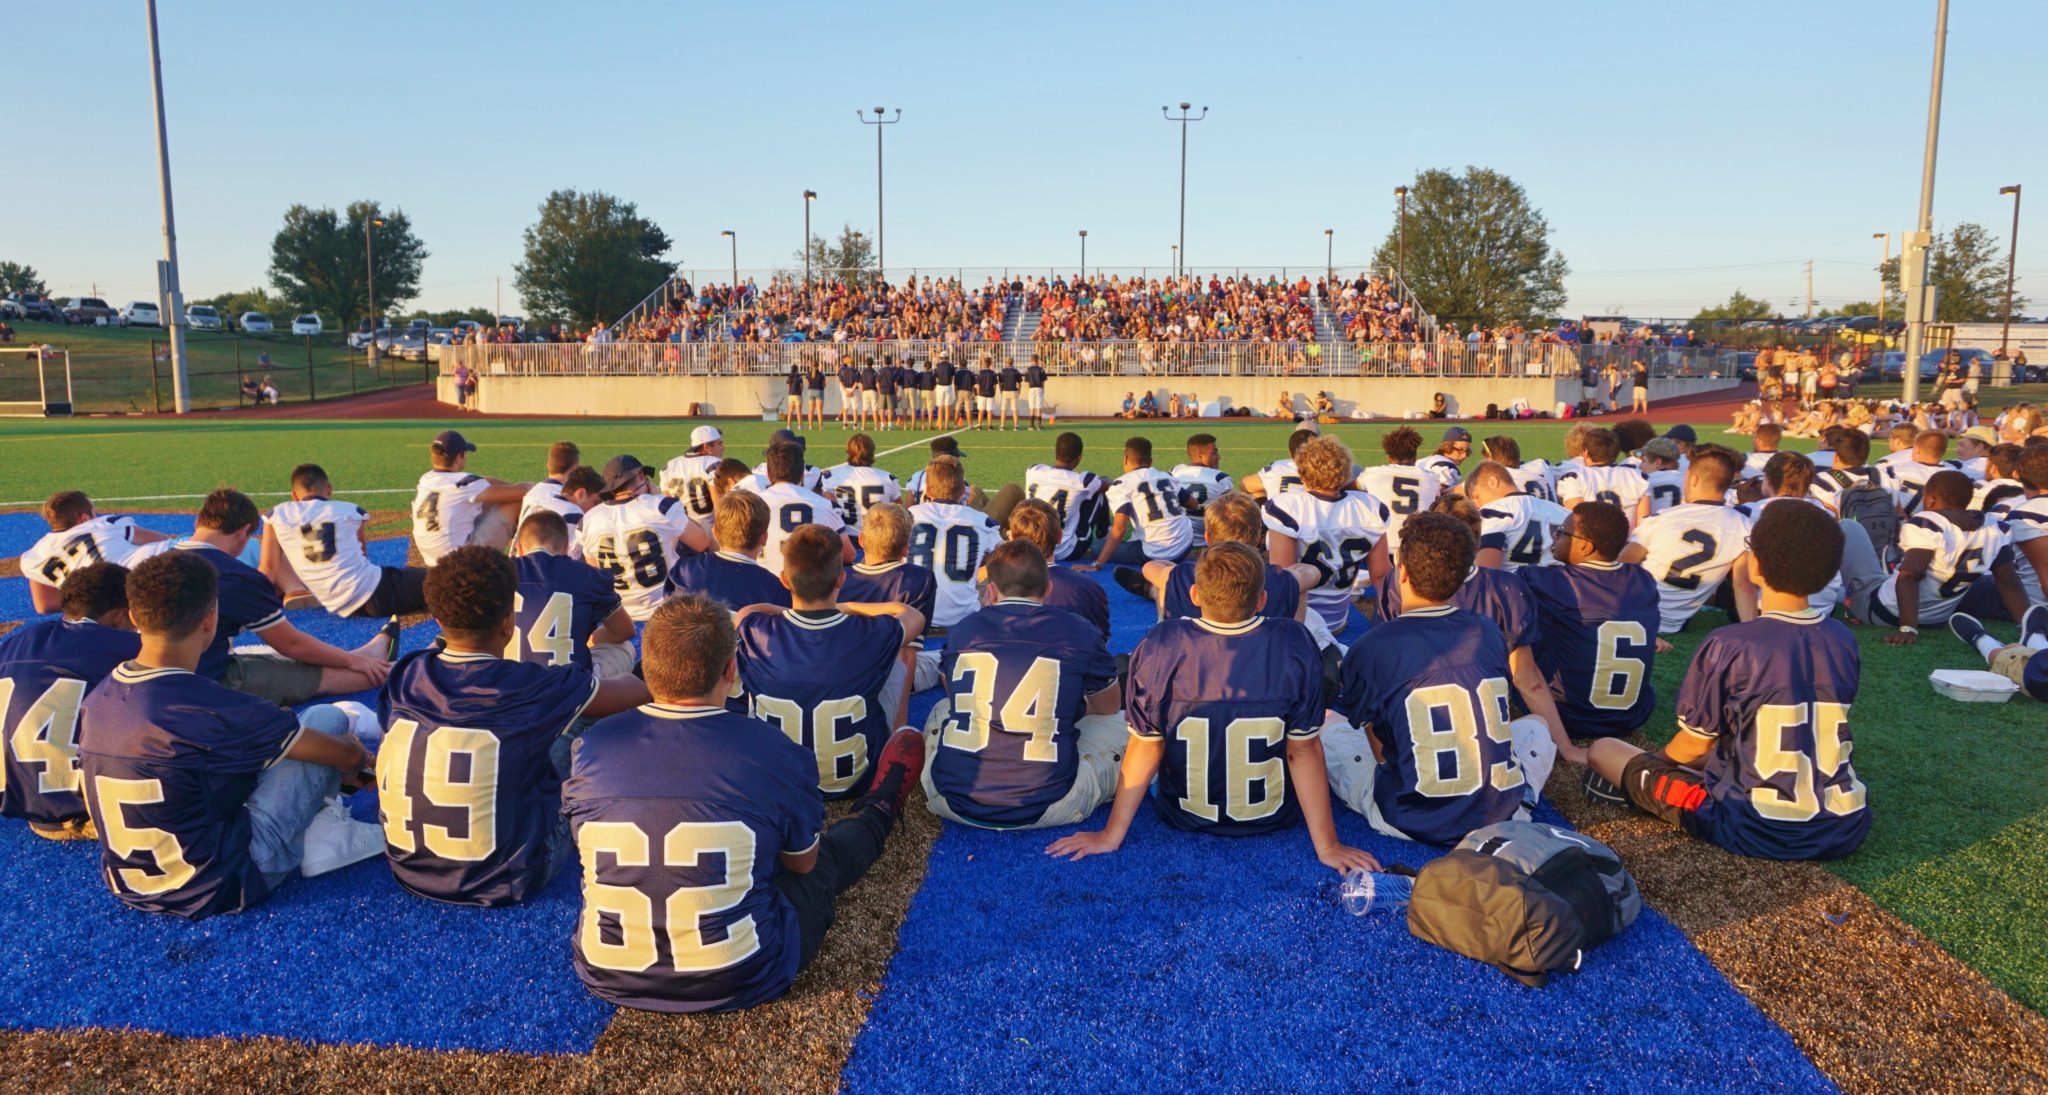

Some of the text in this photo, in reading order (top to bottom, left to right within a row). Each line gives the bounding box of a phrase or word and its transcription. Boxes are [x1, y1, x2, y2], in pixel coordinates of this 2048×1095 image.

[416, 492, 441, 531] 4
[836, 485, 885, 525] 35
[1392, 475, 1420, 514] 5
[908, 522, 979, 582] 80
[1664, 528, 1717, 590] 2
[942, 652, 1061, 763] 34
[1589, 620, 1647, 711] 6
[375, 717, 501, 862] 49
[1176, 716, 1287, 823] 16
[1405, 676, 1525, 799] 89
[1751, 701, 1867, 822] 55
[95, 774, 196, 896] 5
[578, 820, 762, 973] 62
